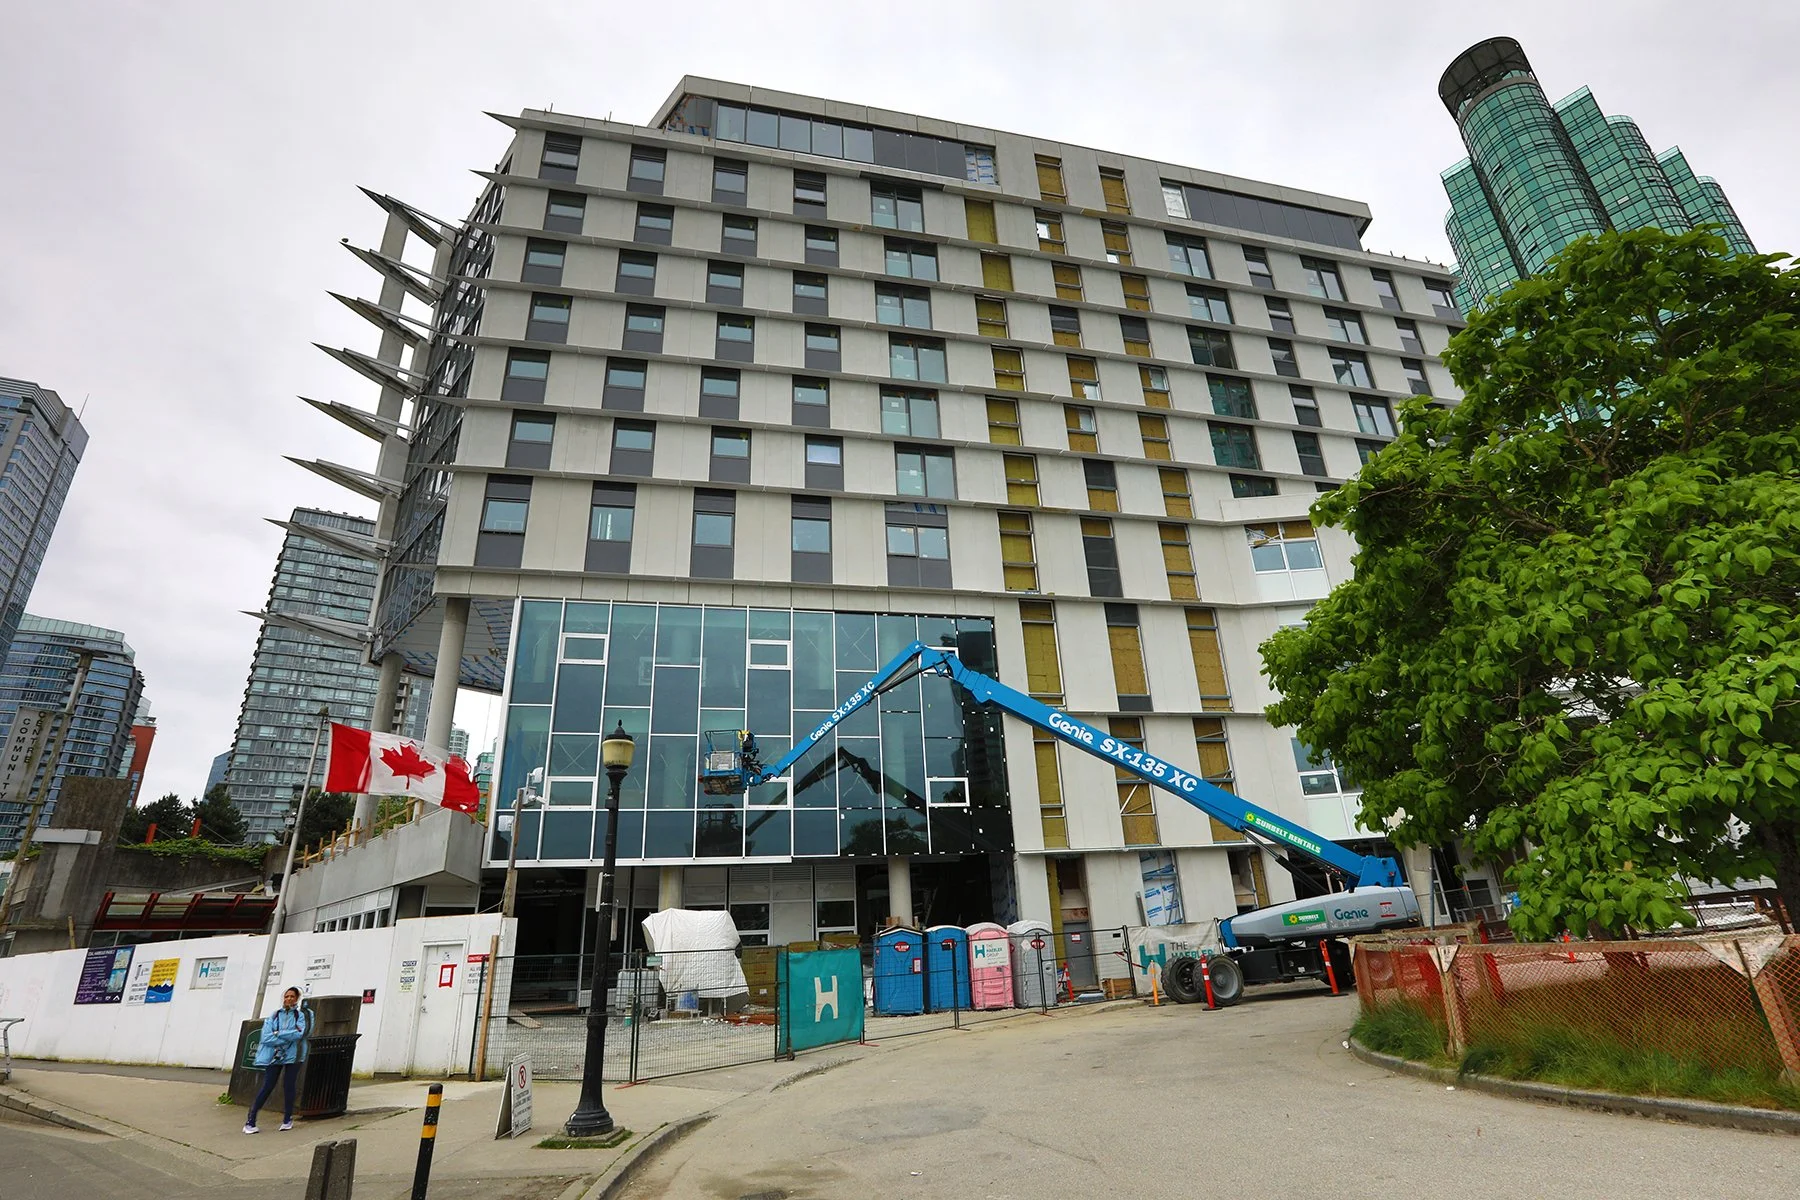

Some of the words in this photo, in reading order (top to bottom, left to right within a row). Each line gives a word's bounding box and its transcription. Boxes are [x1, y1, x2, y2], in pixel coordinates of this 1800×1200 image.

[809, 721, 834, 741] Genie
[832, 692, 862, 722] SX-135
[860, 681, 875, 696] XC
[0, 718, 31, 799] COMMUNITY
[24, 711, 46, 763] CENTRE
[1048, 713, 1094, 745] Genie
[1100, 738, 1168, 778] SX-135
[1167, 769, 1198, 792] XC
[1255, 817, 1288, 838] SUNBELT
[1288, 832, 1321, 854] RENTALS
[1298, 913, 1319, 921] SUNBELT
[1334, 908, 1369, 921] Genie
[1170, 941, 1188, 951] THE
